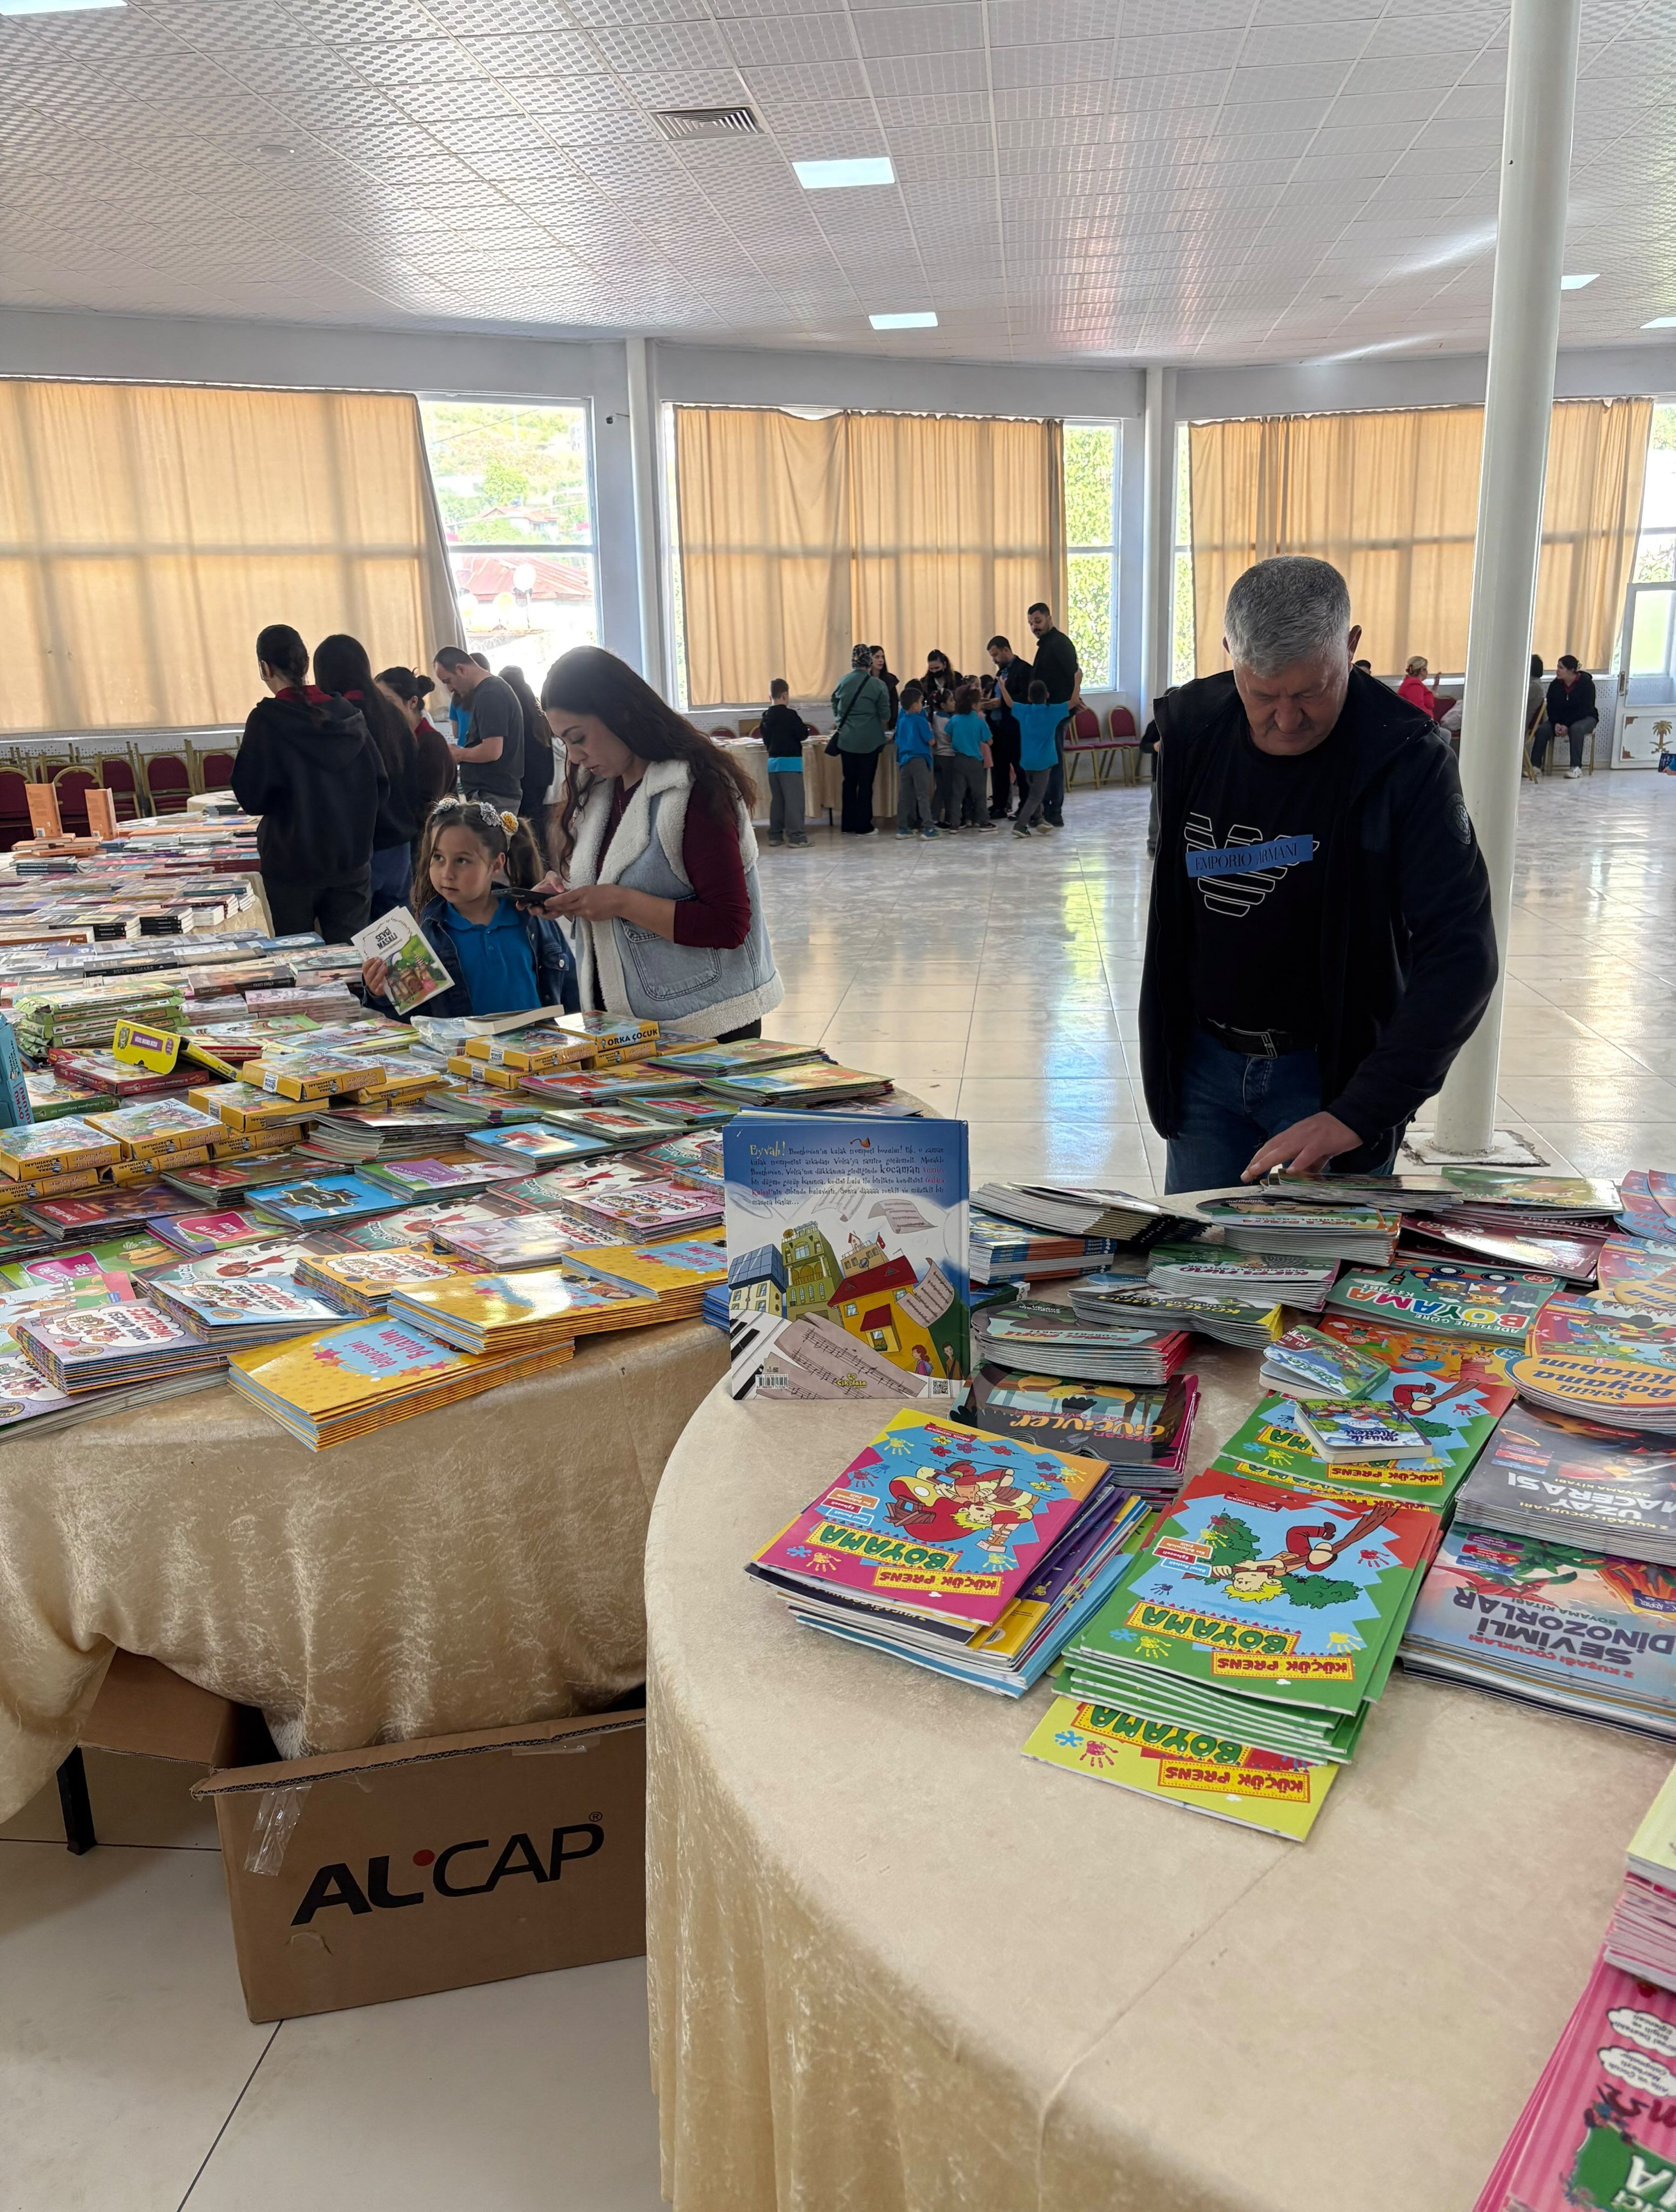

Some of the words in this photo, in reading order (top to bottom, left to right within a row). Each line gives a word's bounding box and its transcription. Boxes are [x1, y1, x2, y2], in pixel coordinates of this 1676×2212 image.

[1195, 852, 1252, 871] EMPORIO
[1257, 842, 1298, 864] ARMANI
[375, 926, 392, 942] SEVGİ
[377, 933, 398, 950] MASALI
[608, 1035, 630, 1046] ORKA
[632, 1029, 658, 1042] ÇOCUK
[750, 1141, 785, 1159] Eyvah!
[25, 1159, 52, 1168] YAYINLARI
[880, 1164, 920, 1174] kocaman
[74, 1263, 92, 1276] Fare
[393, 1254, 450, 1276] İNGİLİZCE
[228, 1284, 263, 1299] ÖNCESİ
[249, 1283, 307, 1310] İNGİLİZCE
[1360, 1283, 1415, 1298] KİTABI
[260, 1300, 283, 1311] OKUL
[1346, 1286, 1531, 1330] BOYAMA
[103, 1311, 136, 1330] ÖNCESİ
[126, 1307, 178, 1339] İNGİLİZCE
[1415, 1313, 1450, 1325] GÖRE
[1452, 1320, 1520, 1334] ADETLERE
[134, 1326, 151, 1340] OKUL
[378, 1329, 434, 1359] Bulalım
[344, 1341, 398, 1368] Gölgesini
[1538, 1357, 1676, 1385] Kitabım
[1532, 1370, 1676, 1399] Boyama
[1556, 1385, 1628, 1400] Şekilli
[926, 1426, 952, 1437] YAYINCILIK
[1093, 1431, 1154, 1444] Afacan
[1331, 1467, 1382, 1478] PRENS
[1388, 1472, 1439, 1482] KÜÇÜK
[1226, 1495, 1255, 1506] YAYINCILIK
[1256, 1503, 1276, 1512] GÖNÜL
[1548, 1498, 1643, 1520] UZAY
[1519, 1501, 1599, 1520] ÇOCUKLARI
[1602, 1516, 1657, 1528] KUŞAĞI
[818, 1525, 950, 1571] BOYAMA
[879, 1571, 936, 1586] PRENS
[940, 1575, 998, 1590] KÜÇÜK
[1452, 1586, 1676, 1655] DİNOZORLAR
[1559, 1608, 1618, 1626] BOYAMA
[1140, 1606, 1288, 1654] BOYAMA
[1469, 1634, 1557, 1662] ÇOCUKLARI
[1476, 1616, 1633, 1666] SEVİMLİ
[1217, 1657, 1279, 1672] PRENS
[1286, 1659, 1348, 1675] KÜÇÜK
[1559, 1656, 1620, 1675] KUŞAĞI
[1089, 1704, 1242, 1765] BOYAMA
[1165, 1766, 1231, 1785] PRENS
[1237, 1773, 1304, 1794] KÜÇÜK
